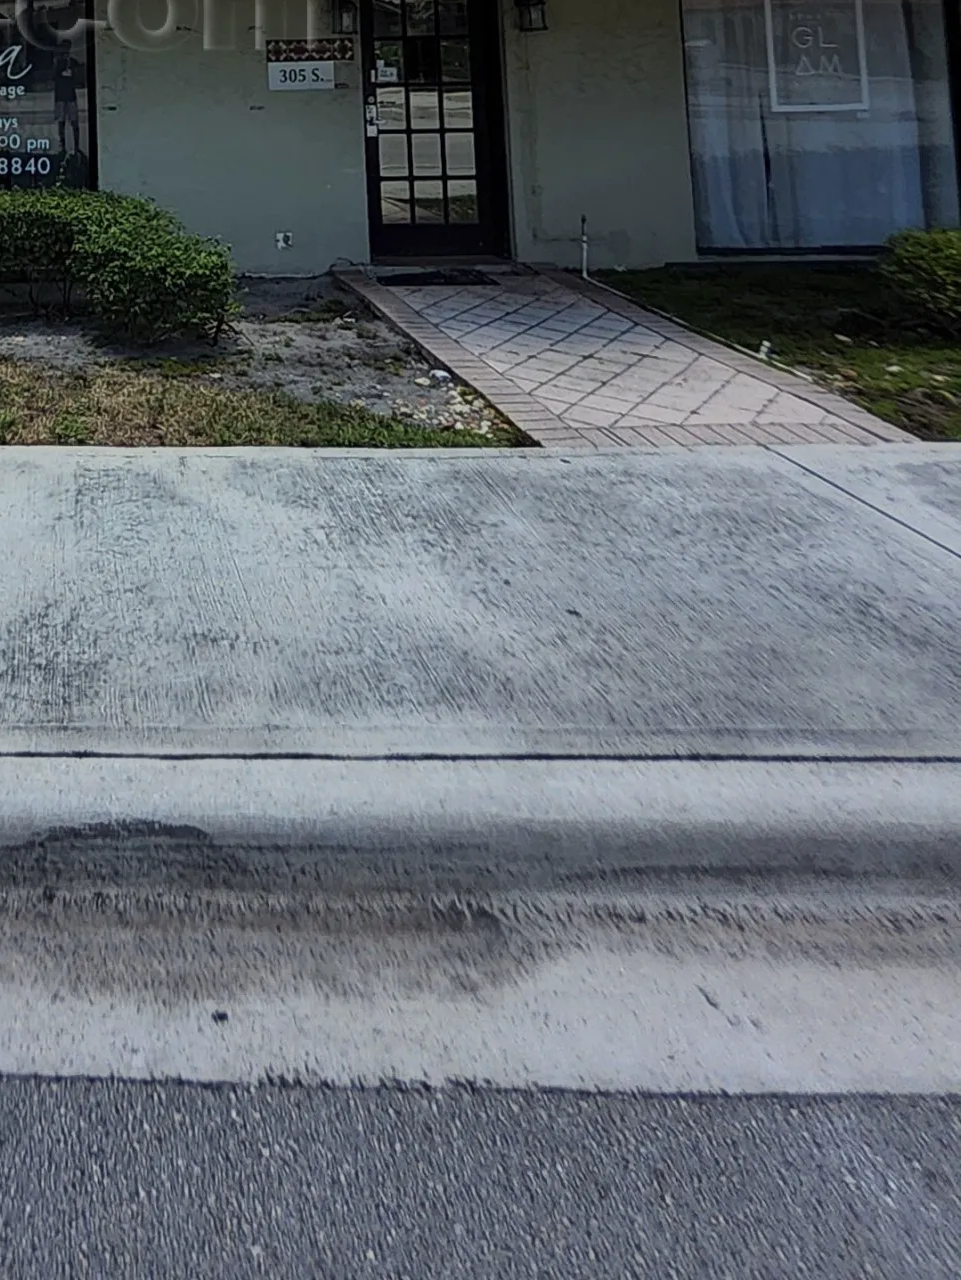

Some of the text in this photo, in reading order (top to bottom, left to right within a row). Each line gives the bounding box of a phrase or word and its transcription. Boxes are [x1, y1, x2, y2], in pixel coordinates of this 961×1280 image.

[279, 68, 324, 83] 305 S.
[26, 137, 51, 152] pm
